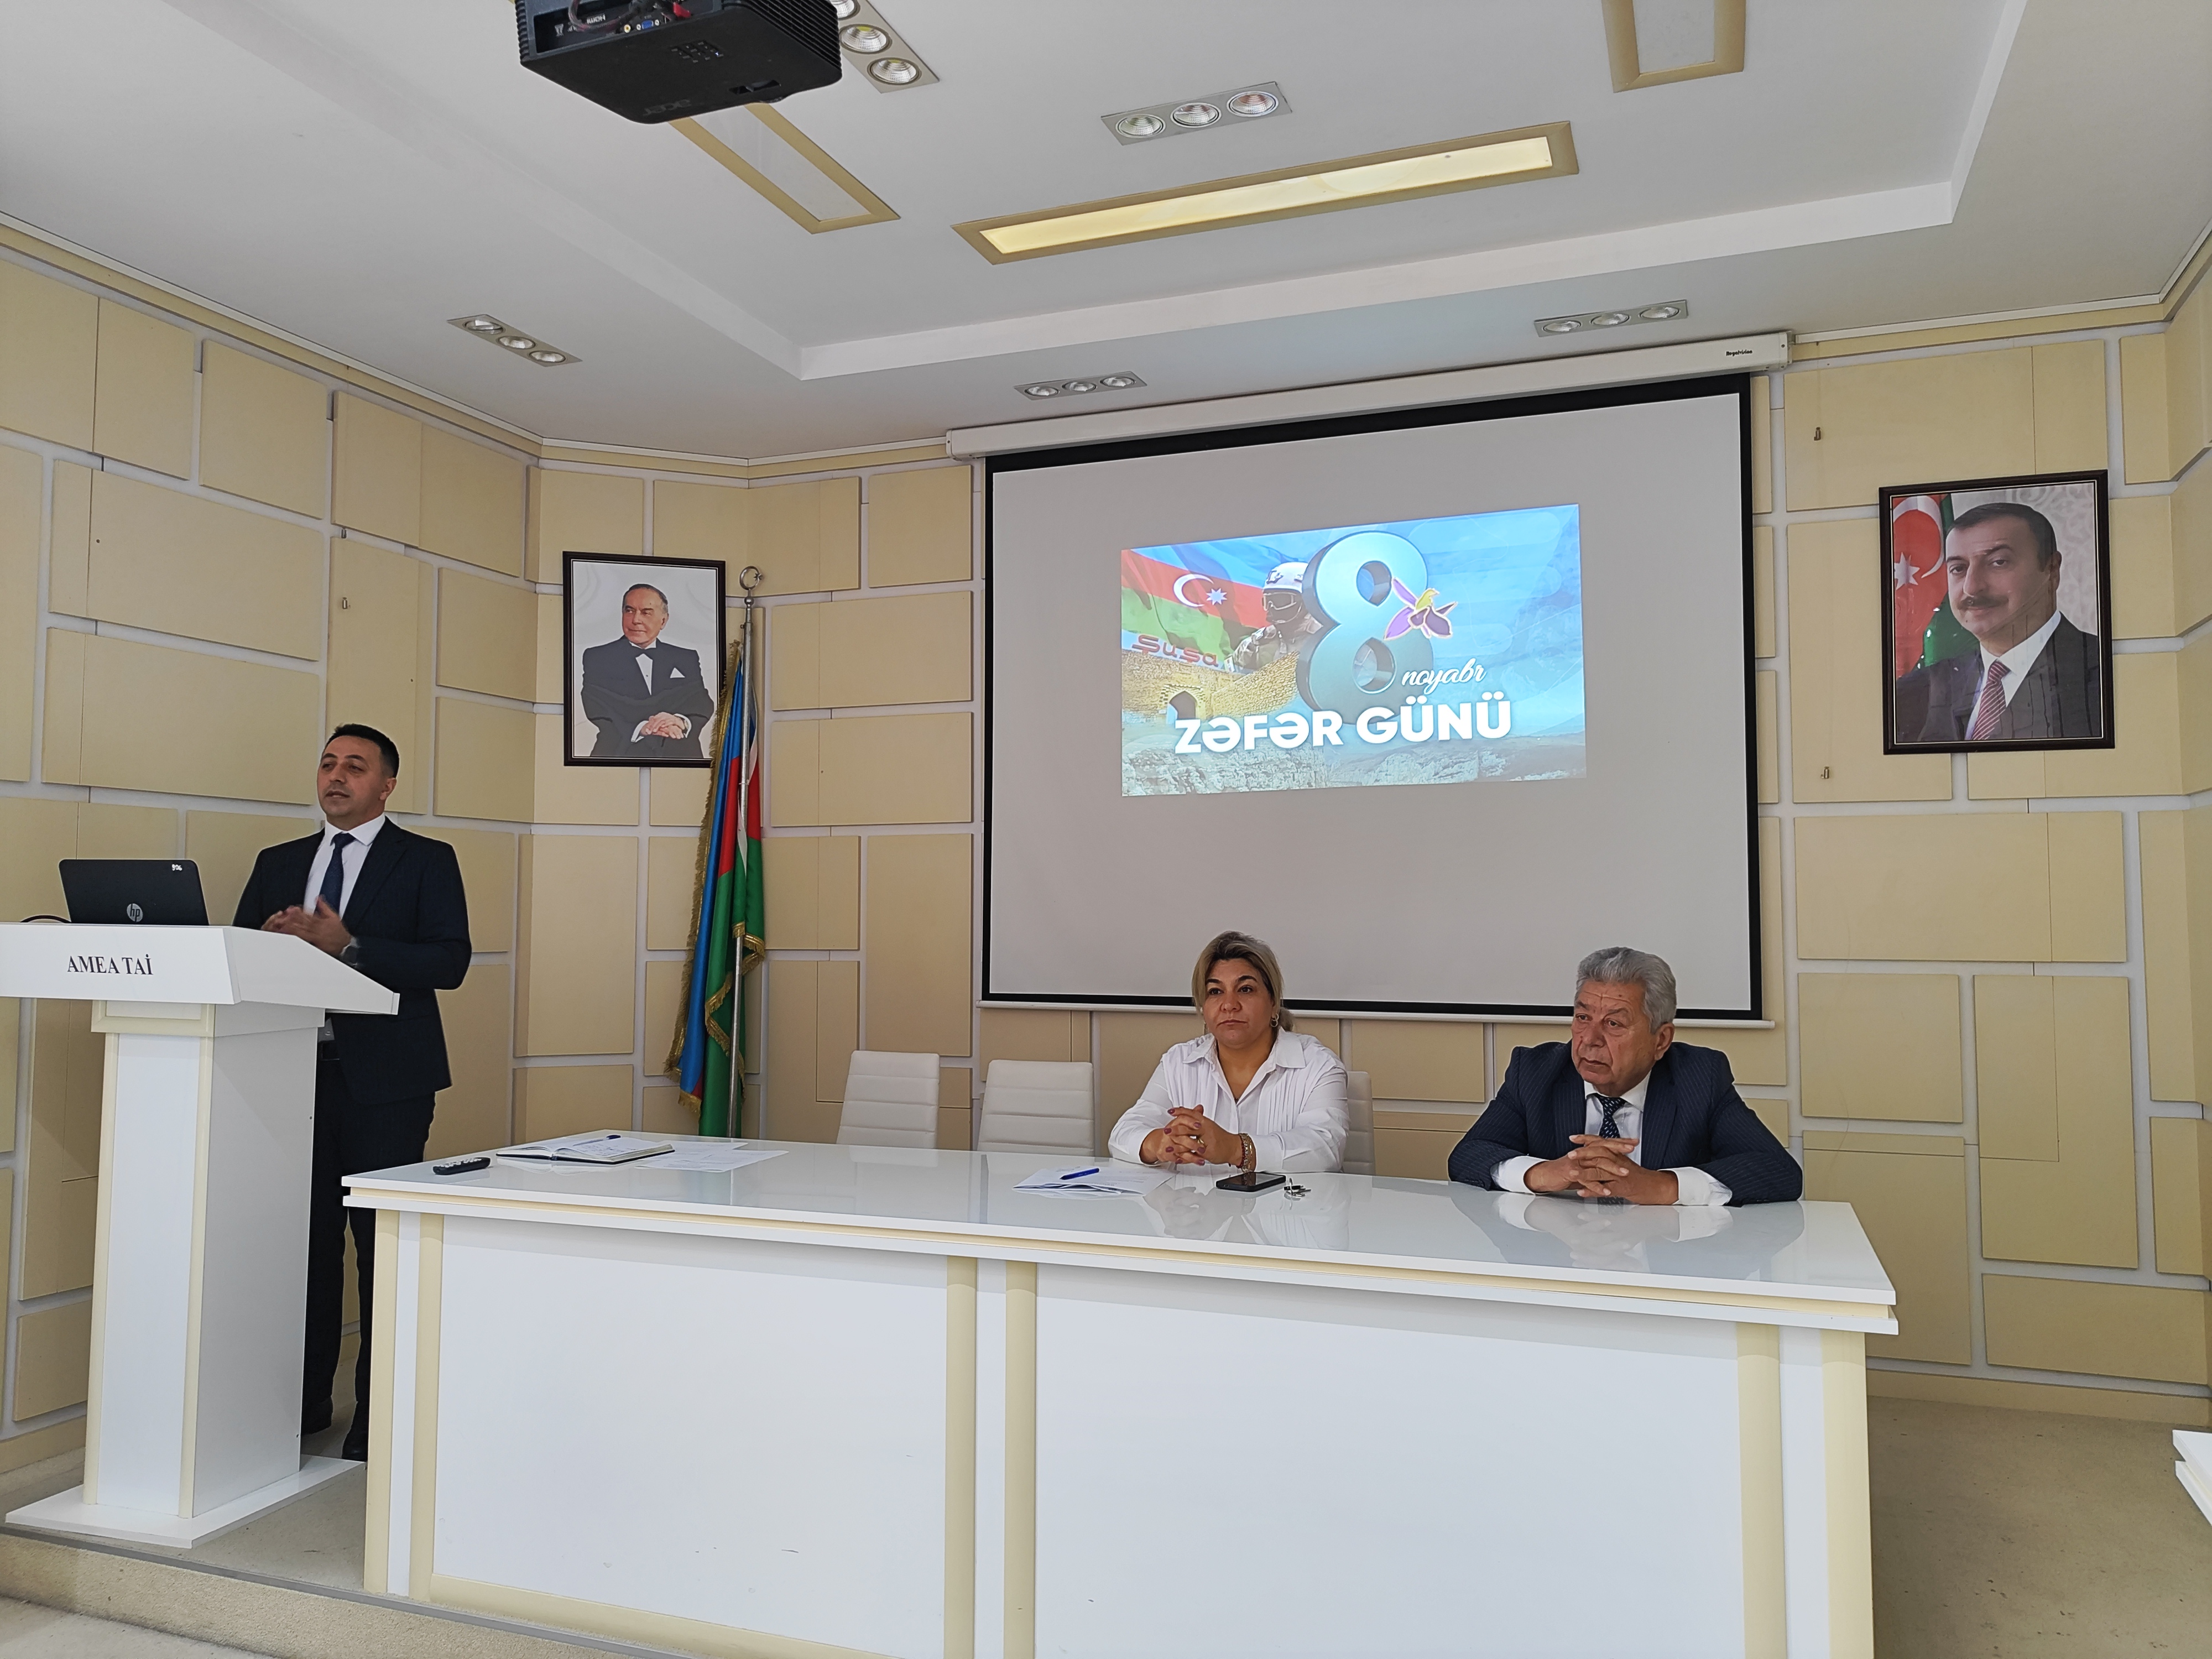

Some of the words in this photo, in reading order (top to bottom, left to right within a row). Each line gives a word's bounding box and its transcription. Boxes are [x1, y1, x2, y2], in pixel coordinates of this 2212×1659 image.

[1297, 531, 1434, 724] 8
[1132, 634, 1219, 667] Şuşa
[1401, 658, 1487, 695] noyabr
[1175, 709, 1344, 754] ZƏFƏR
[1356, 691, 1511, 744] GÜNÜ
[128, 903, 142, 922] hp
[67, 956, 121, 974] AMEA
[121, 953, 154, 975] TAİ
